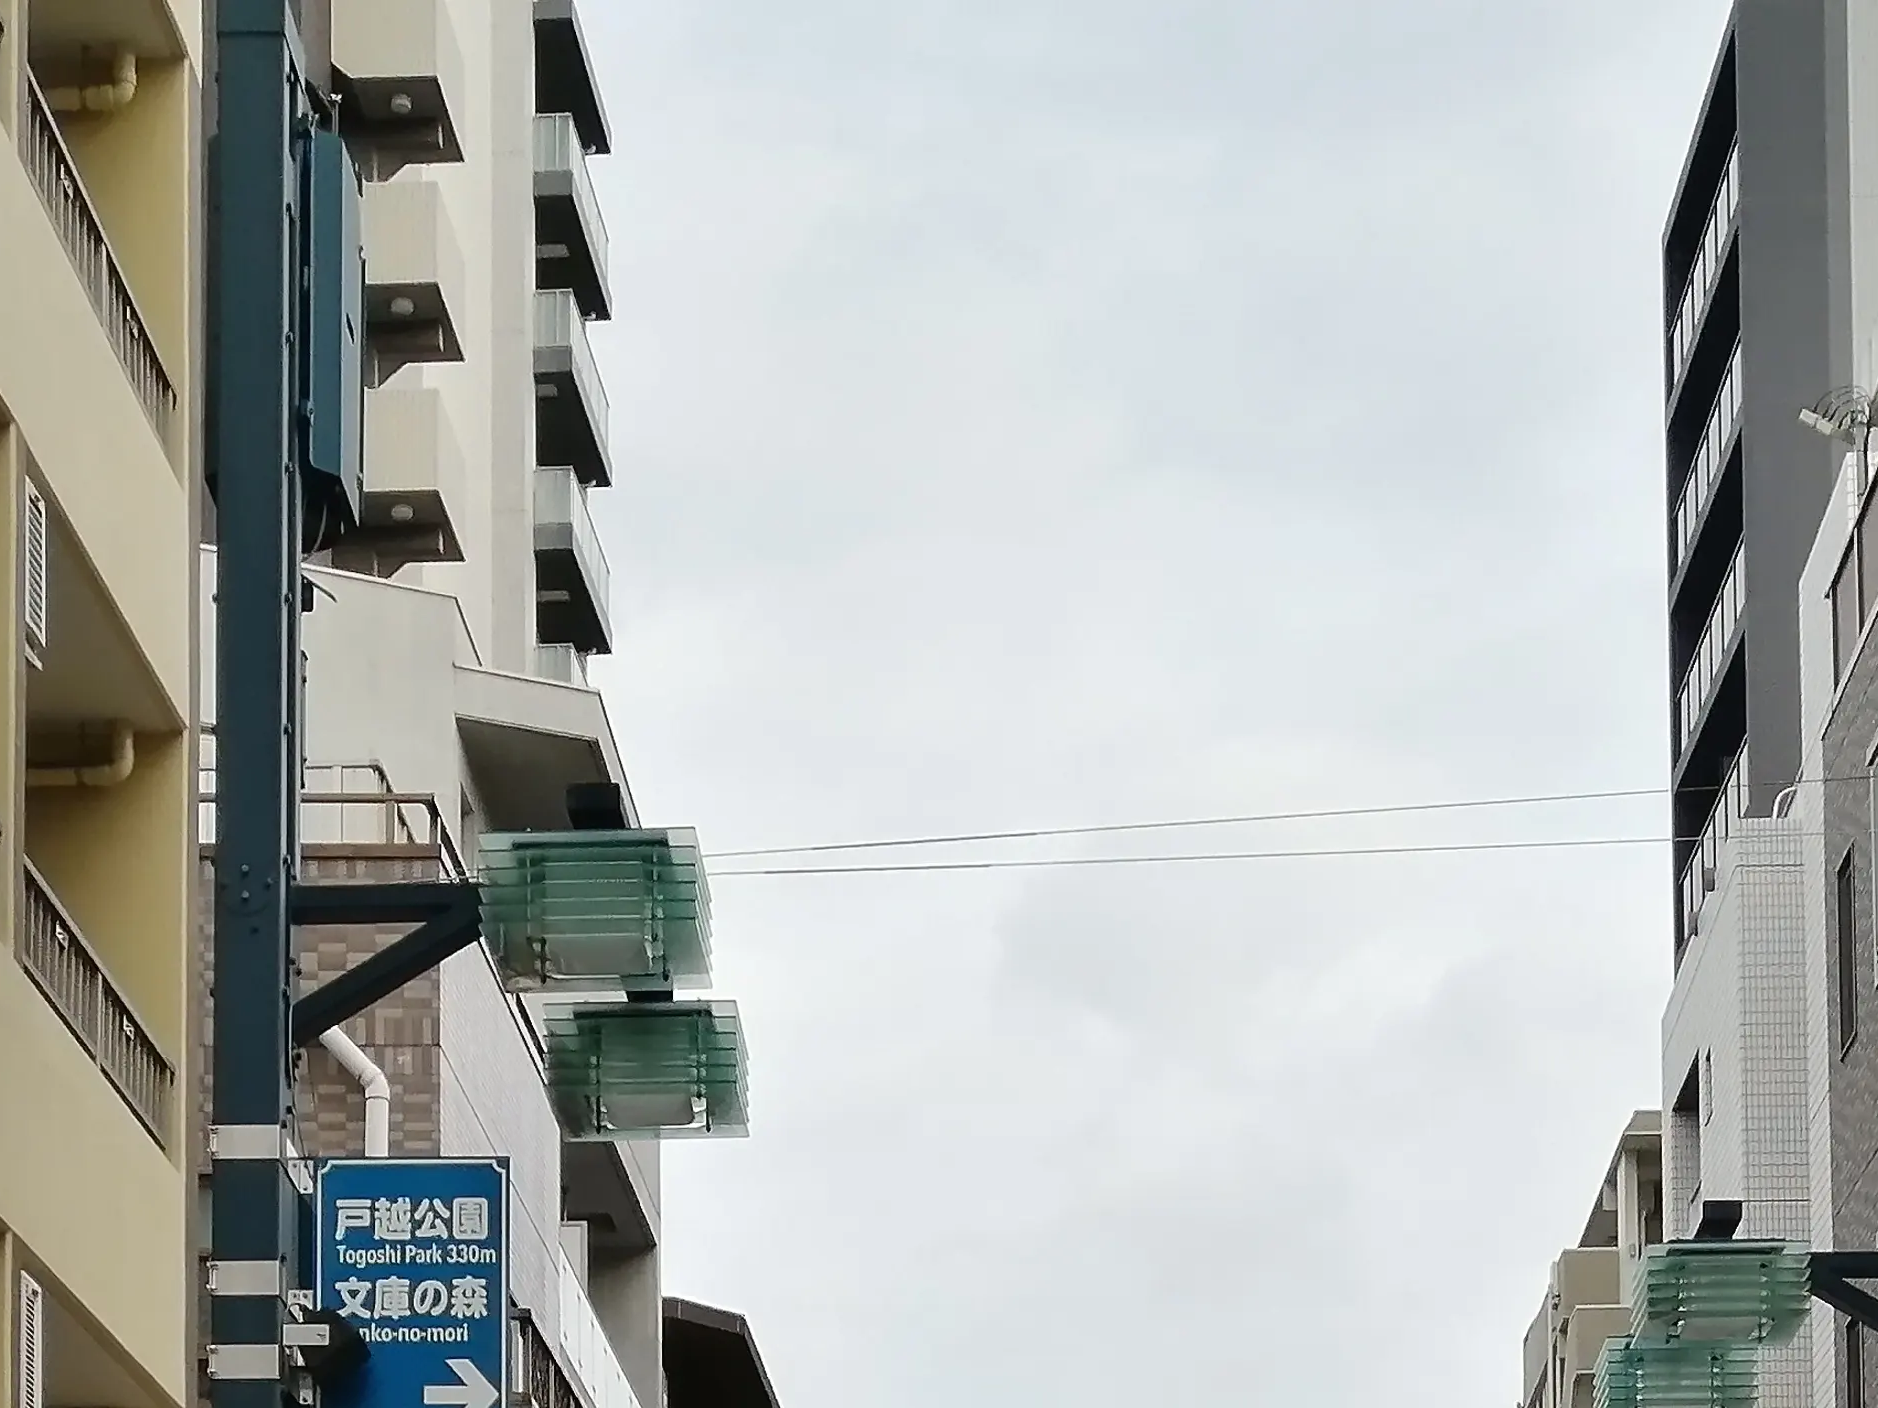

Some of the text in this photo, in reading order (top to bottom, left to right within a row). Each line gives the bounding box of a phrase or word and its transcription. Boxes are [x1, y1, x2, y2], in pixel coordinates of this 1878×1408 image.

[335, 1196, 490, 1241] 戸越公園
[337, 1244, 497, 1269] Togoshi Park 330m
[334, 1275, 489, 1320] 文庫の森
